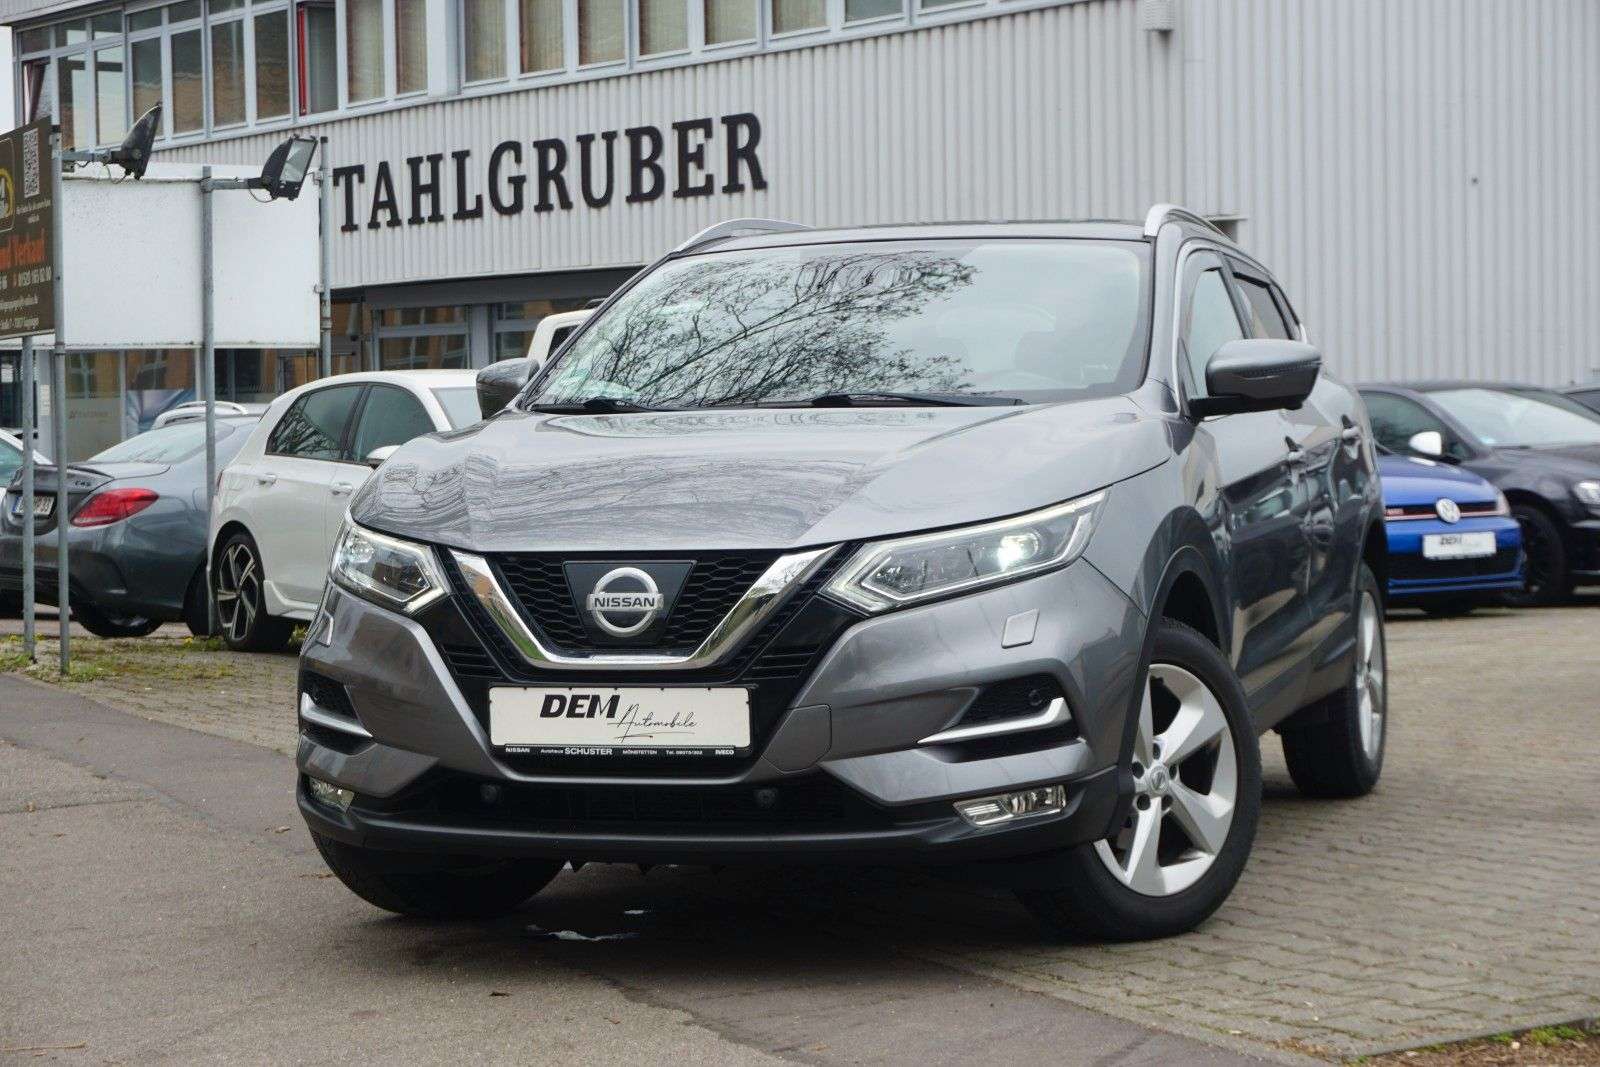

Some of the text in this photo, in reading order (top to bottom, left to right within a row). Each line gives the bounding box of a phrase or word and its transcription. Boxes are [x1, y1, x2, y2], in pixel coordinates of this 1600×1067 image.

[332, 112, 768, 233] TAHLGRUBER
[594, 597, 655, 608] NISSAN
[540, 694, 698, 743] DEM Automobile
[564, 747, 613, 756] SCHUSTER
